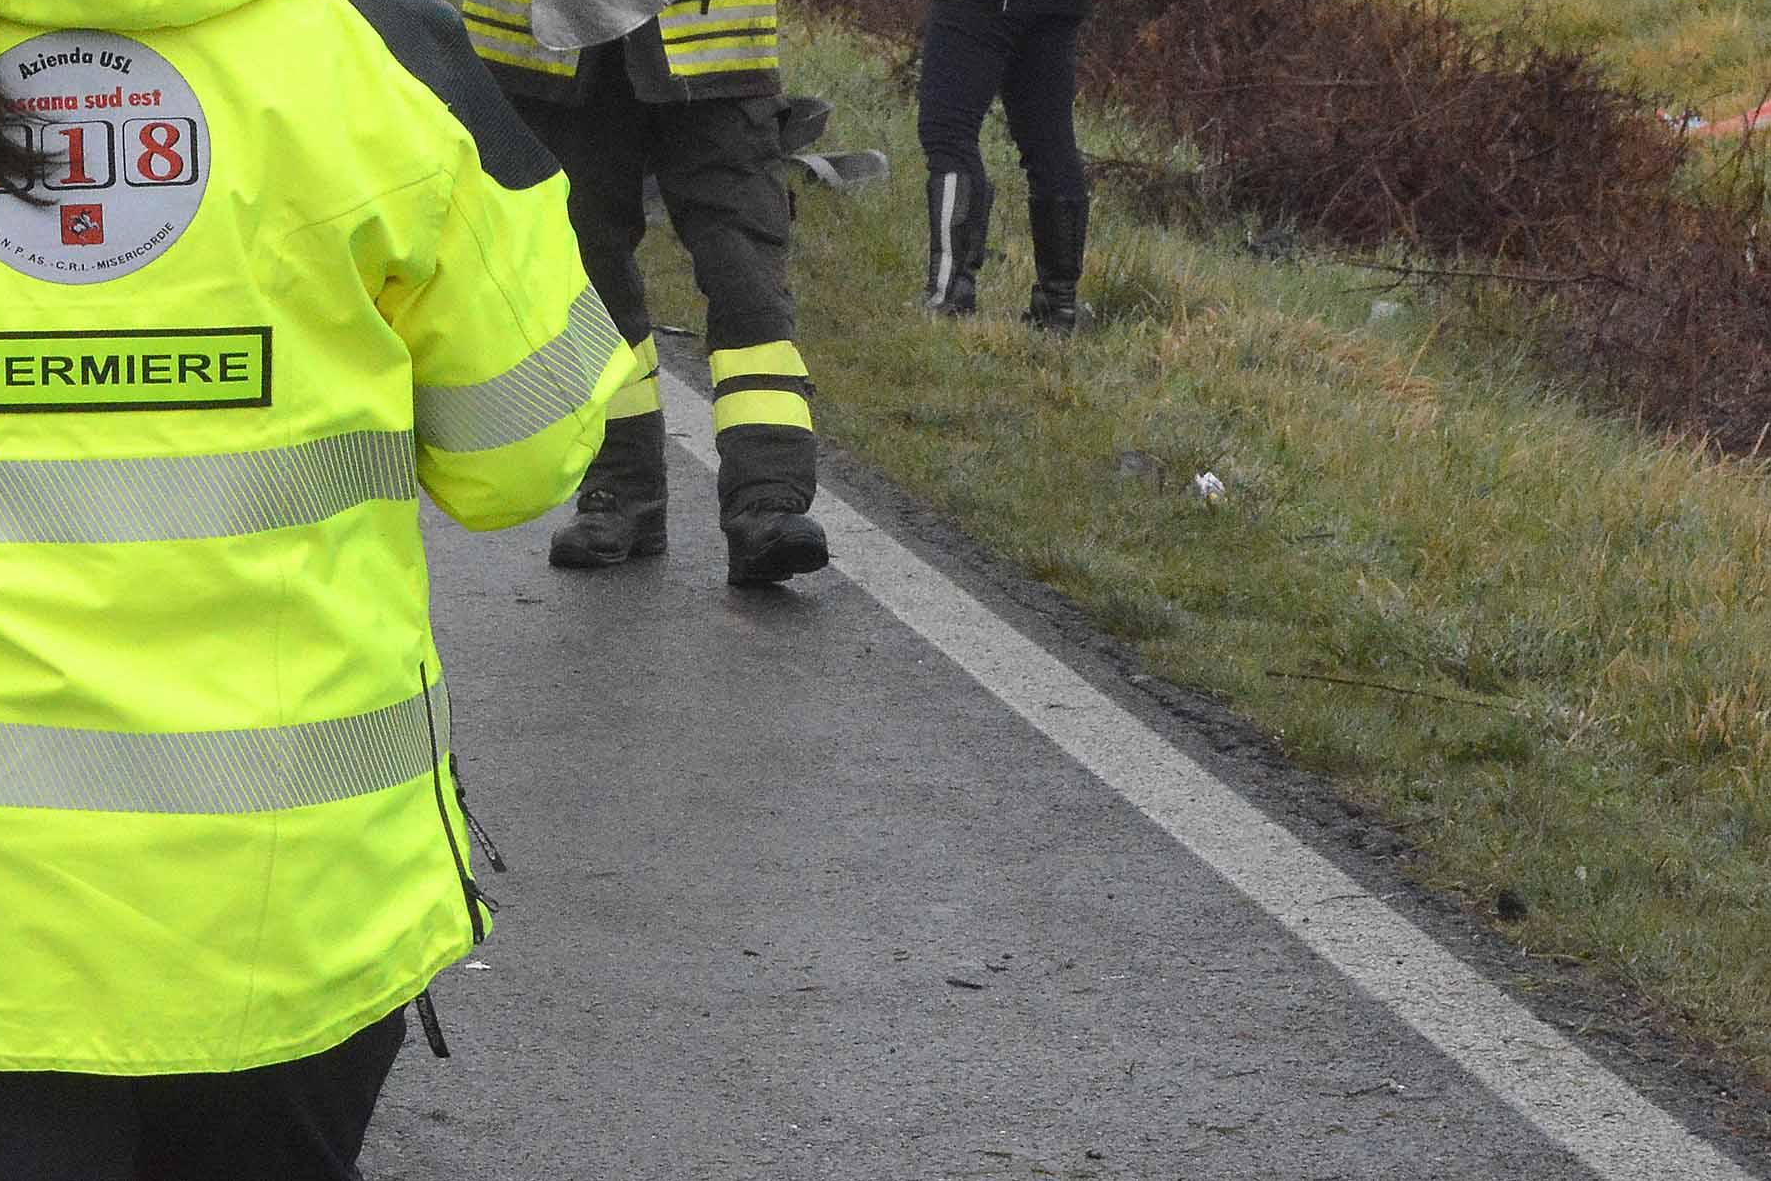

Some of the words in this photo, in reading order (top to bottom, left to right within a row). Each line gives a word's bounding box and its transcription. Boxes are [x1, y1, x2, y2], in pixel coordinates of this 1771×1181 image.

[18, 46, 95, 80] Azienda
[99, 50, 134, 75] USL
[83, 86, 123, 110] sud
[128, 89, 163, 107] est
